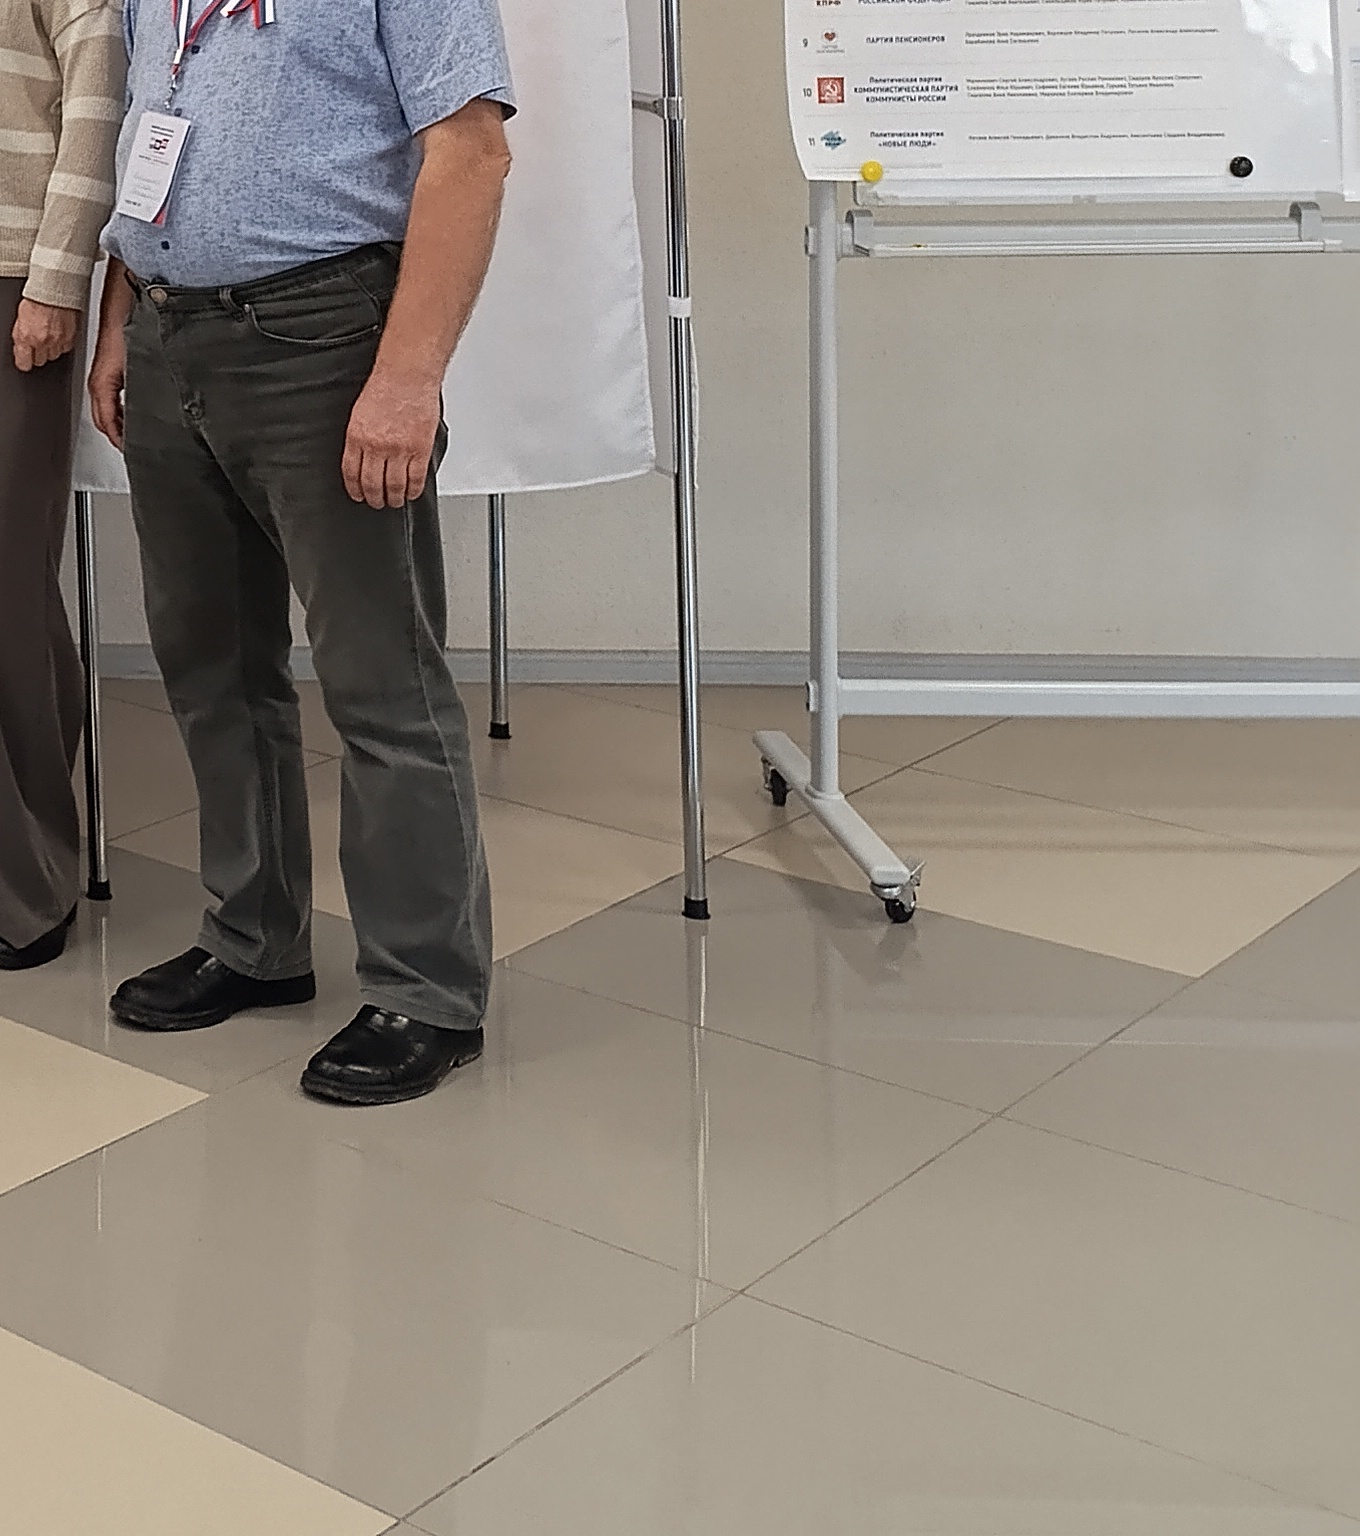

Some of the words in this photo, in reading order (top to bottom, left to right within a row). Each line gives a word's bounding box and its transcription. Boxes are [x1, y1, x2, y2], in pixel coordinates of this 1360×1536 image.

[866, 36, 894, 44] ПАРТИЯ
[894, 35, 946, 44] ПЕНСИОНЕРОВ
[869, 76, 918, 84] Политическая
[918, 76, 943, 84] партия
[803, 88, 812, 97] 10
[853, 85, 929, 94] КОММУНИСТИЧЕСКАЯ
[930, 85, 959, 93] ПАРТИЯ
[865, 94, 917, 103] КОММУНИСТЫ
[917, 94, 947, 102] РОССИИ
[870, 131, 919, 139] Политическая
[920, 131, 944, 139] партия
[808, 137, 815, 146] 11
